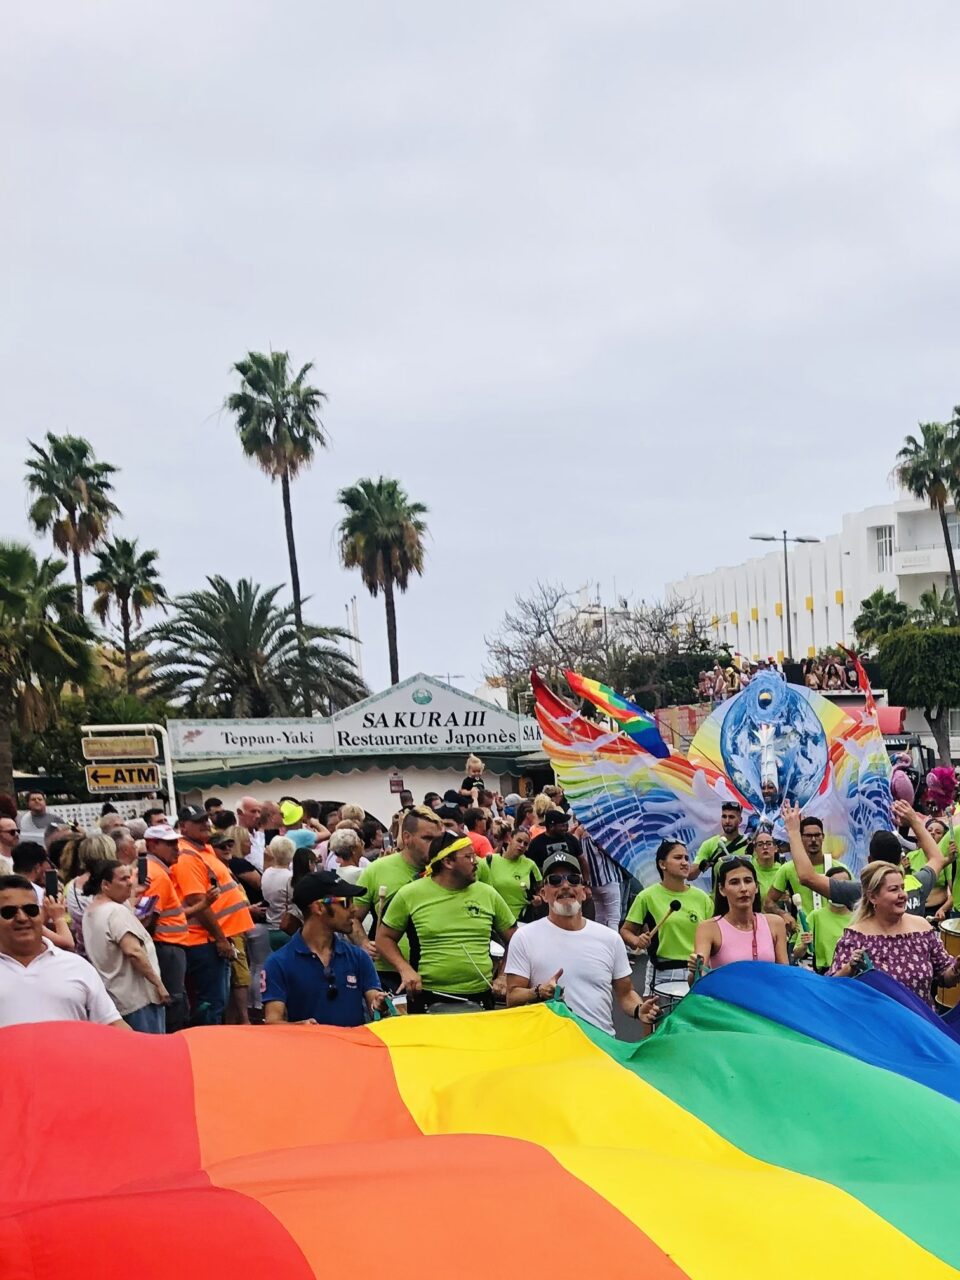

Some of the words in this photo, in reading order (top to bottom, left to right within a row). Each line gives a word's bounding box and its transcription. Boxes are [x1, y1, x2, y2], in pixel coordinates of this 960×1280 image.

[220, 731, 314, 747] Teppan-Yaki
[337, 731, 438, 747] Restaurante
[445, 728, 516, 747] Japonès
[113, 768, 156, 783] ATM
